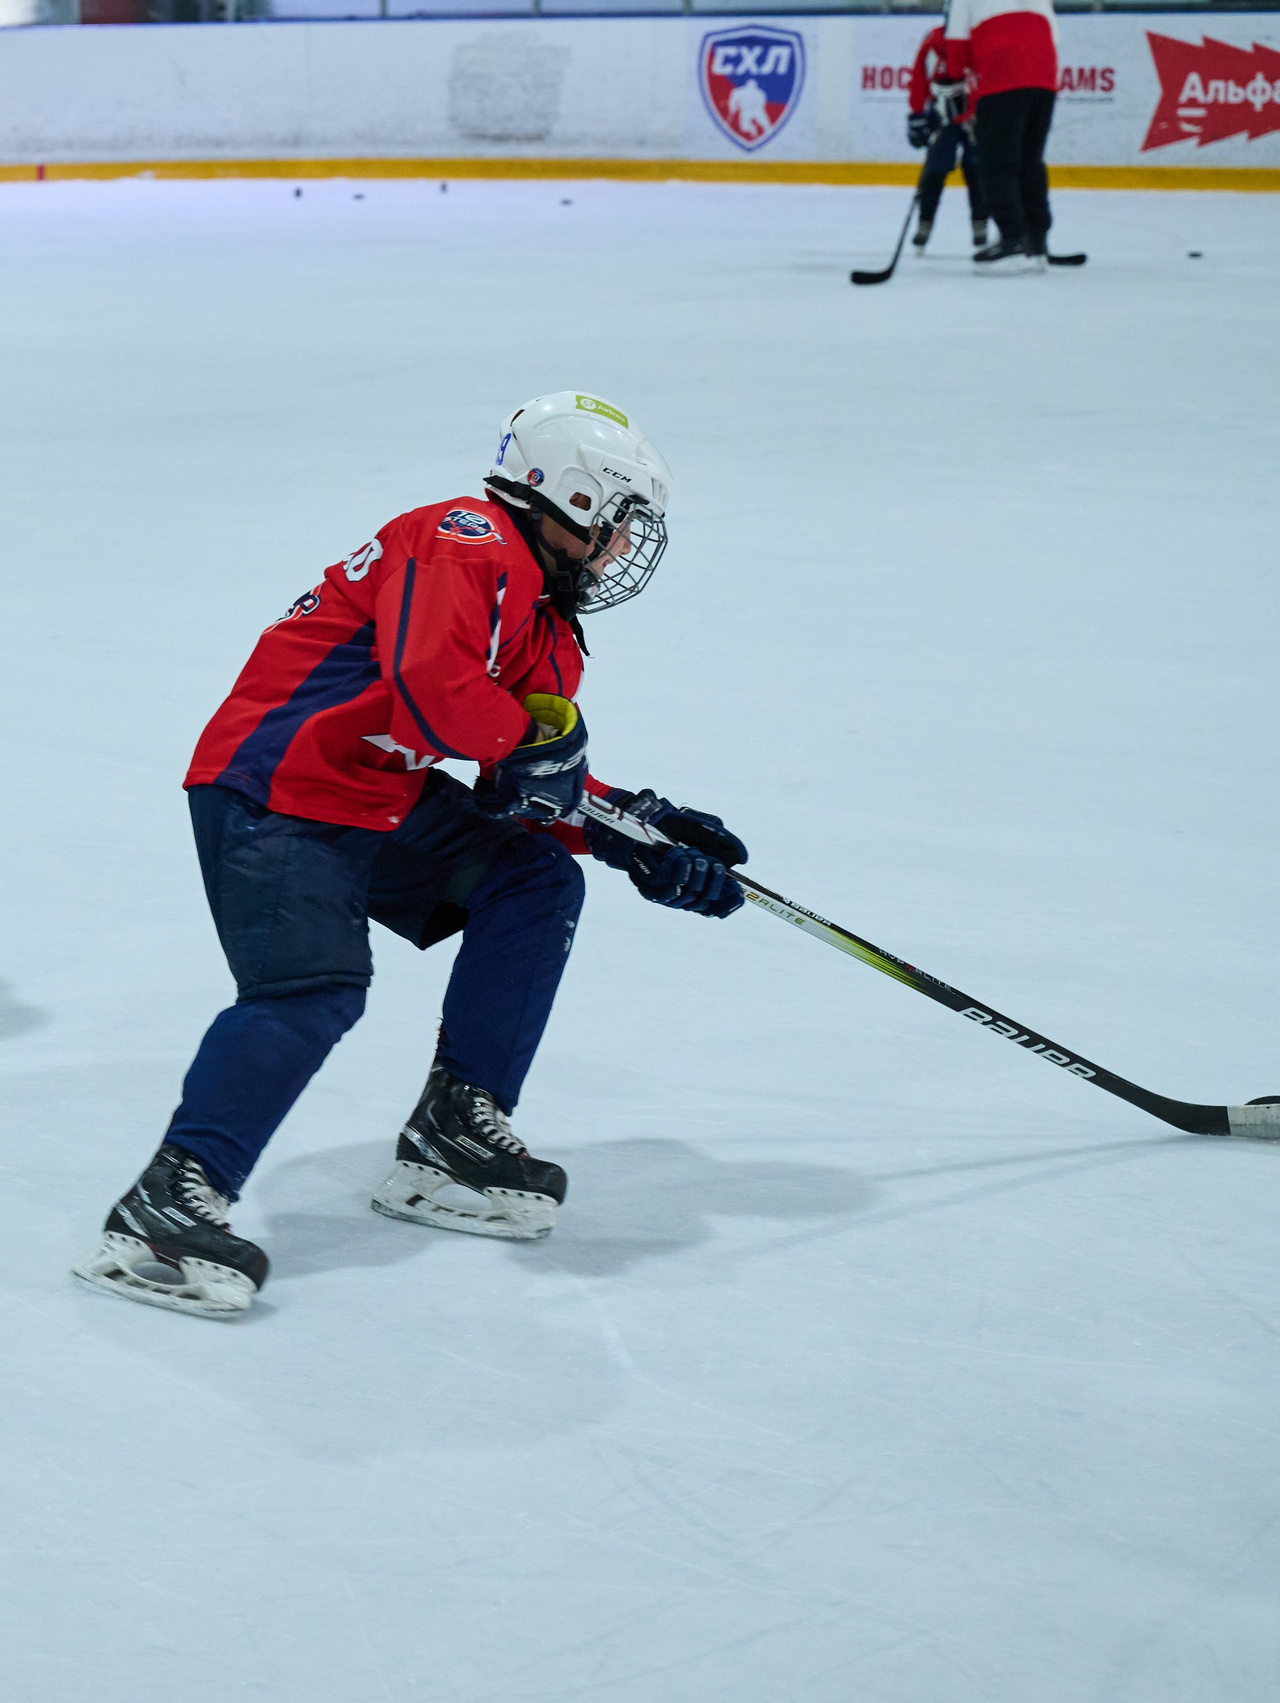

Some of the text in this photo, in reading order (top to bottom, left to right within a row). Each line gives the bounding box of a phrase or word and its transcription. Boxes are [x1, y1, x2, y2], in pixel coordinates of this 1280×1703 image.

[711, 45, 793, 76] СХЛ
[862, 66, 1116, 92] HOC AMS
[602, 467, 632, 483] CCM
[958, 1006, 1097, 1079] BAUER
